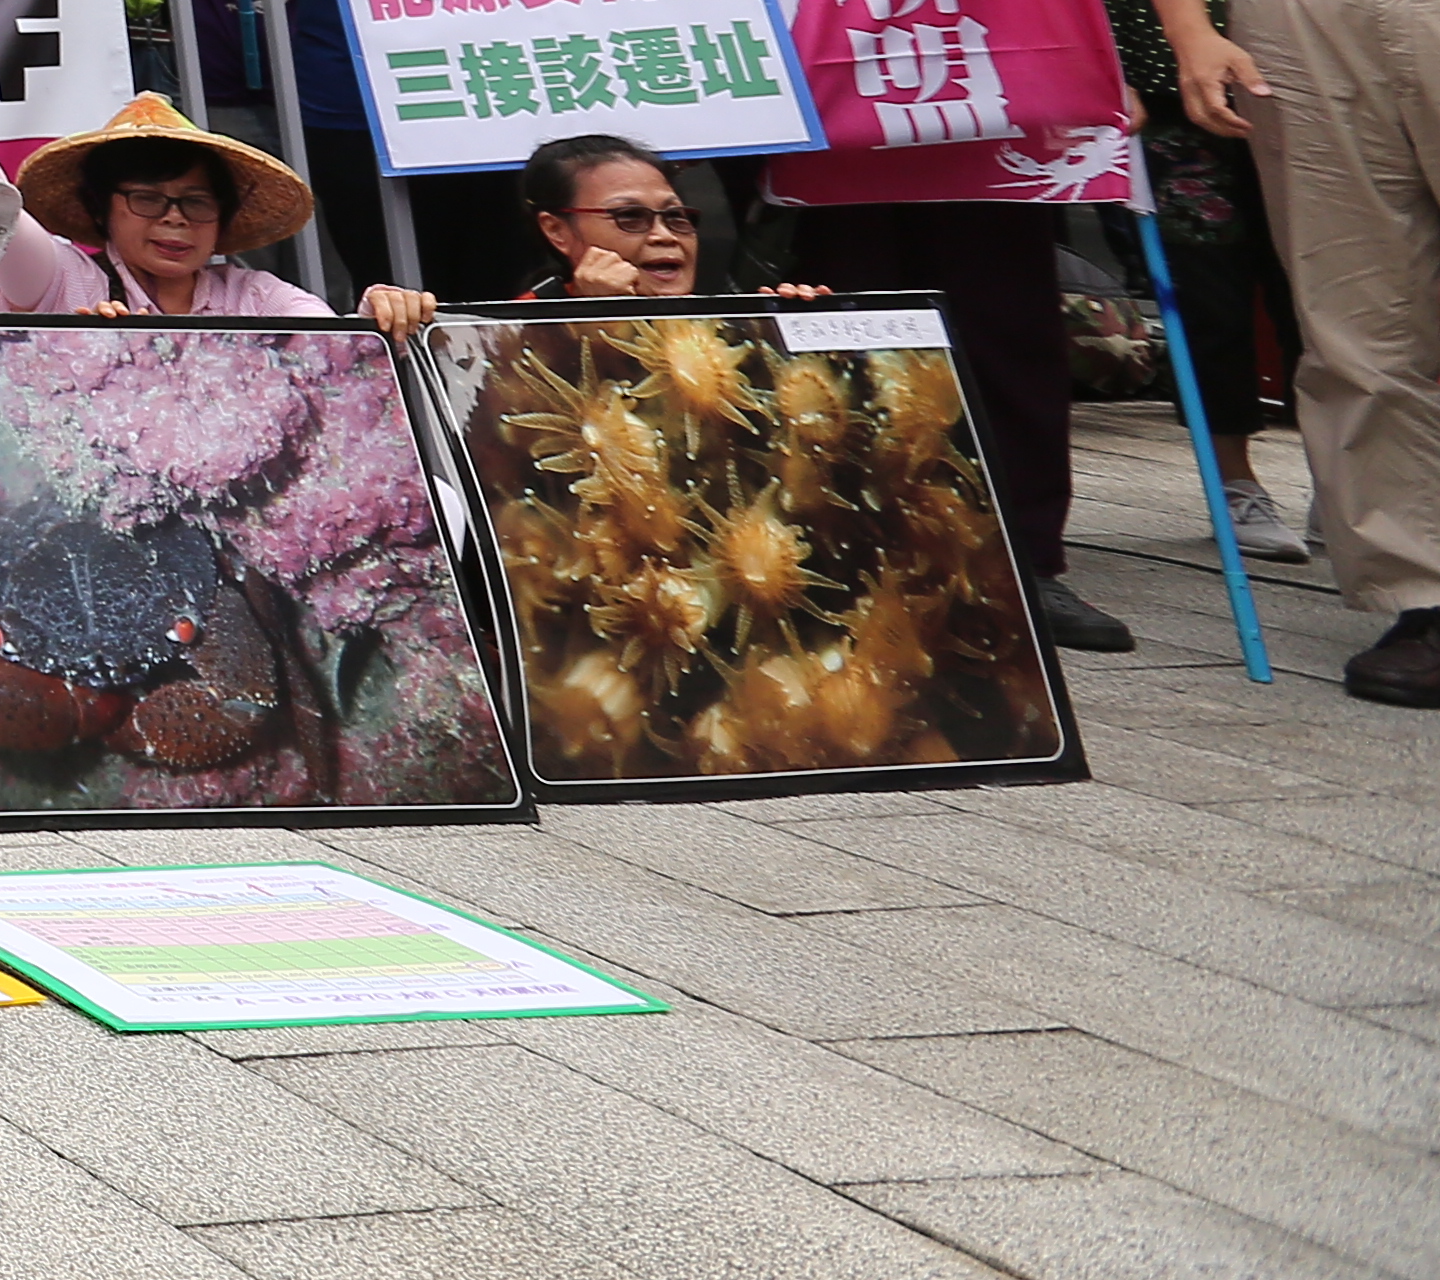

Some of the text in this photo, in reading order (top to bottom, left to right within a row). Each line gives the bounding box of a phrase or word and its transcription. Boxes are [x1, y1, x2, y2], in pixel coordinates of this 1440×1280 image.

[385, 20, 782, 123] 三接該遷址
